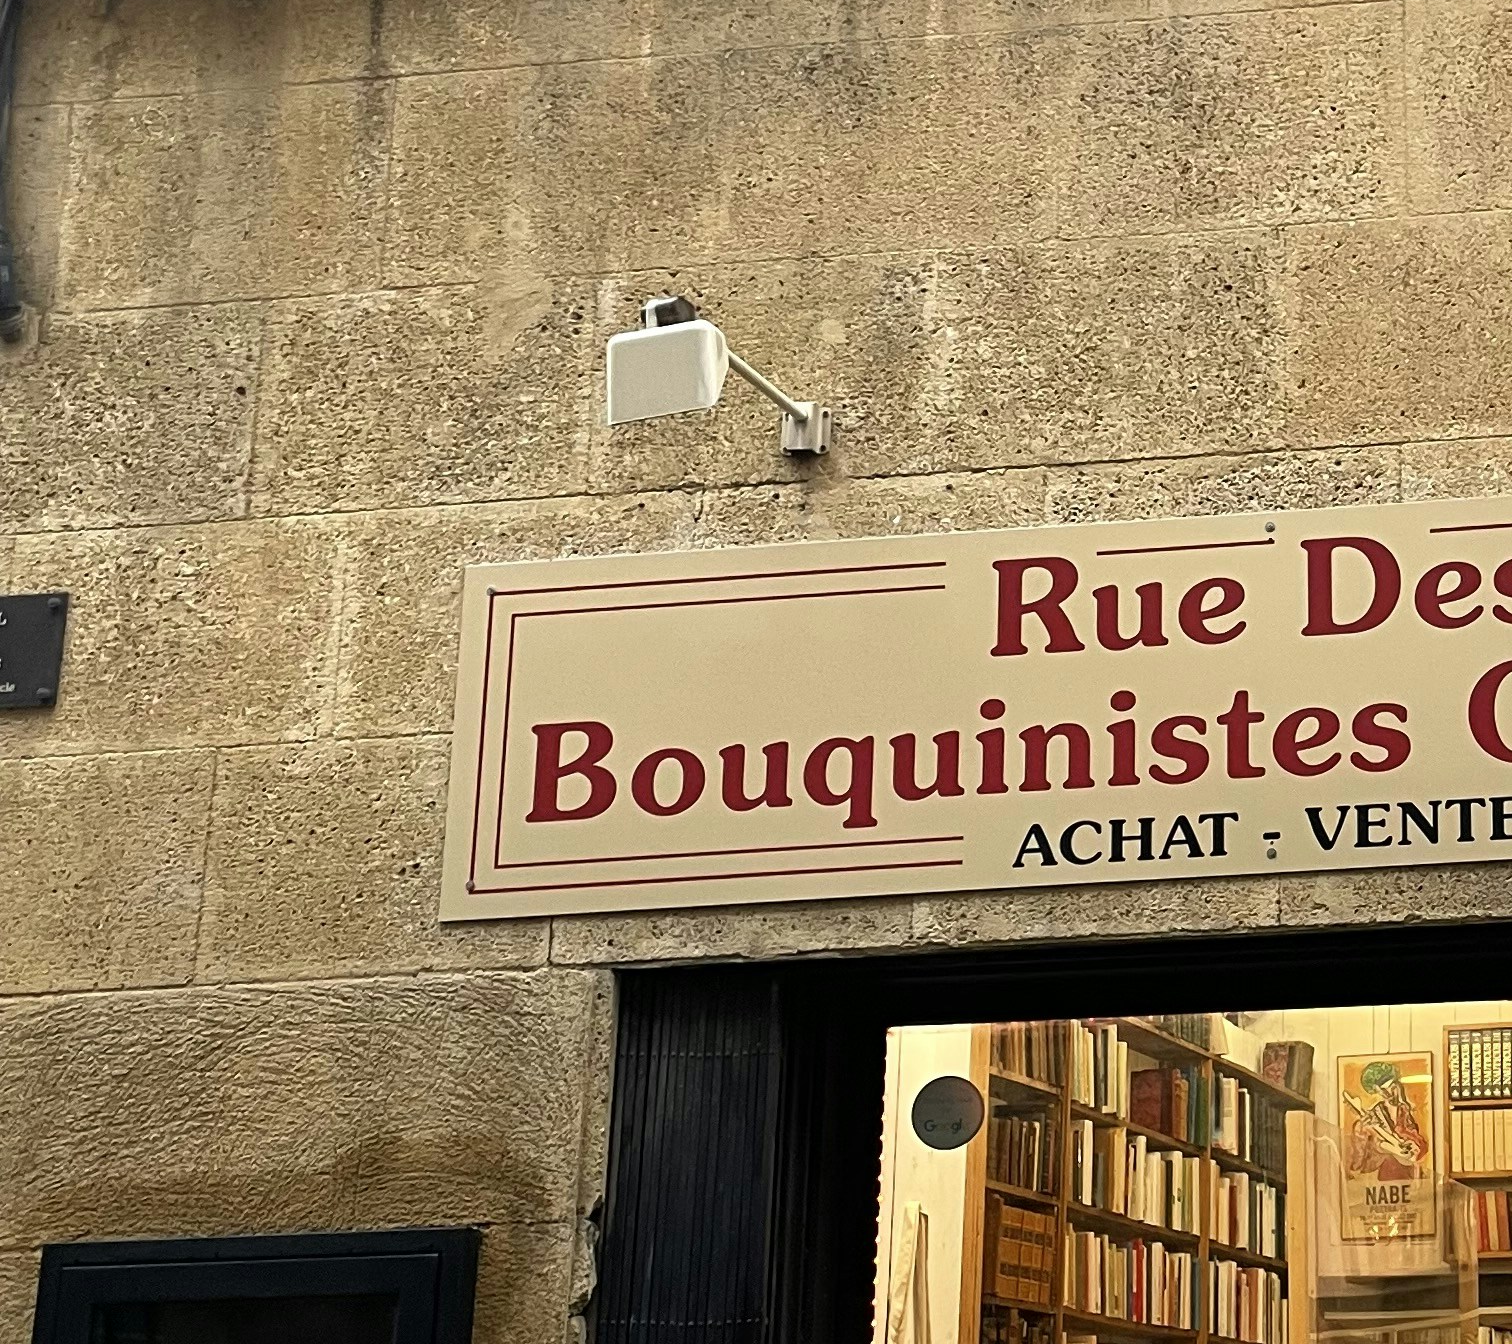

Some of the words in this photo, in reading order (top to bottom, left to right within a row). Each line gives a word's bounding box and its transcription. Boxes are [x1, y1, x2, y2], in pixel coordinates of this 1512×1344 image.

[991, 556, 1246, 656] Rue
[525, 658, 1413, 829] Bouquinistes
[1012, 810, 1240, 869] ACHAT
[1365, 1184, 1412, 1206] NABE
